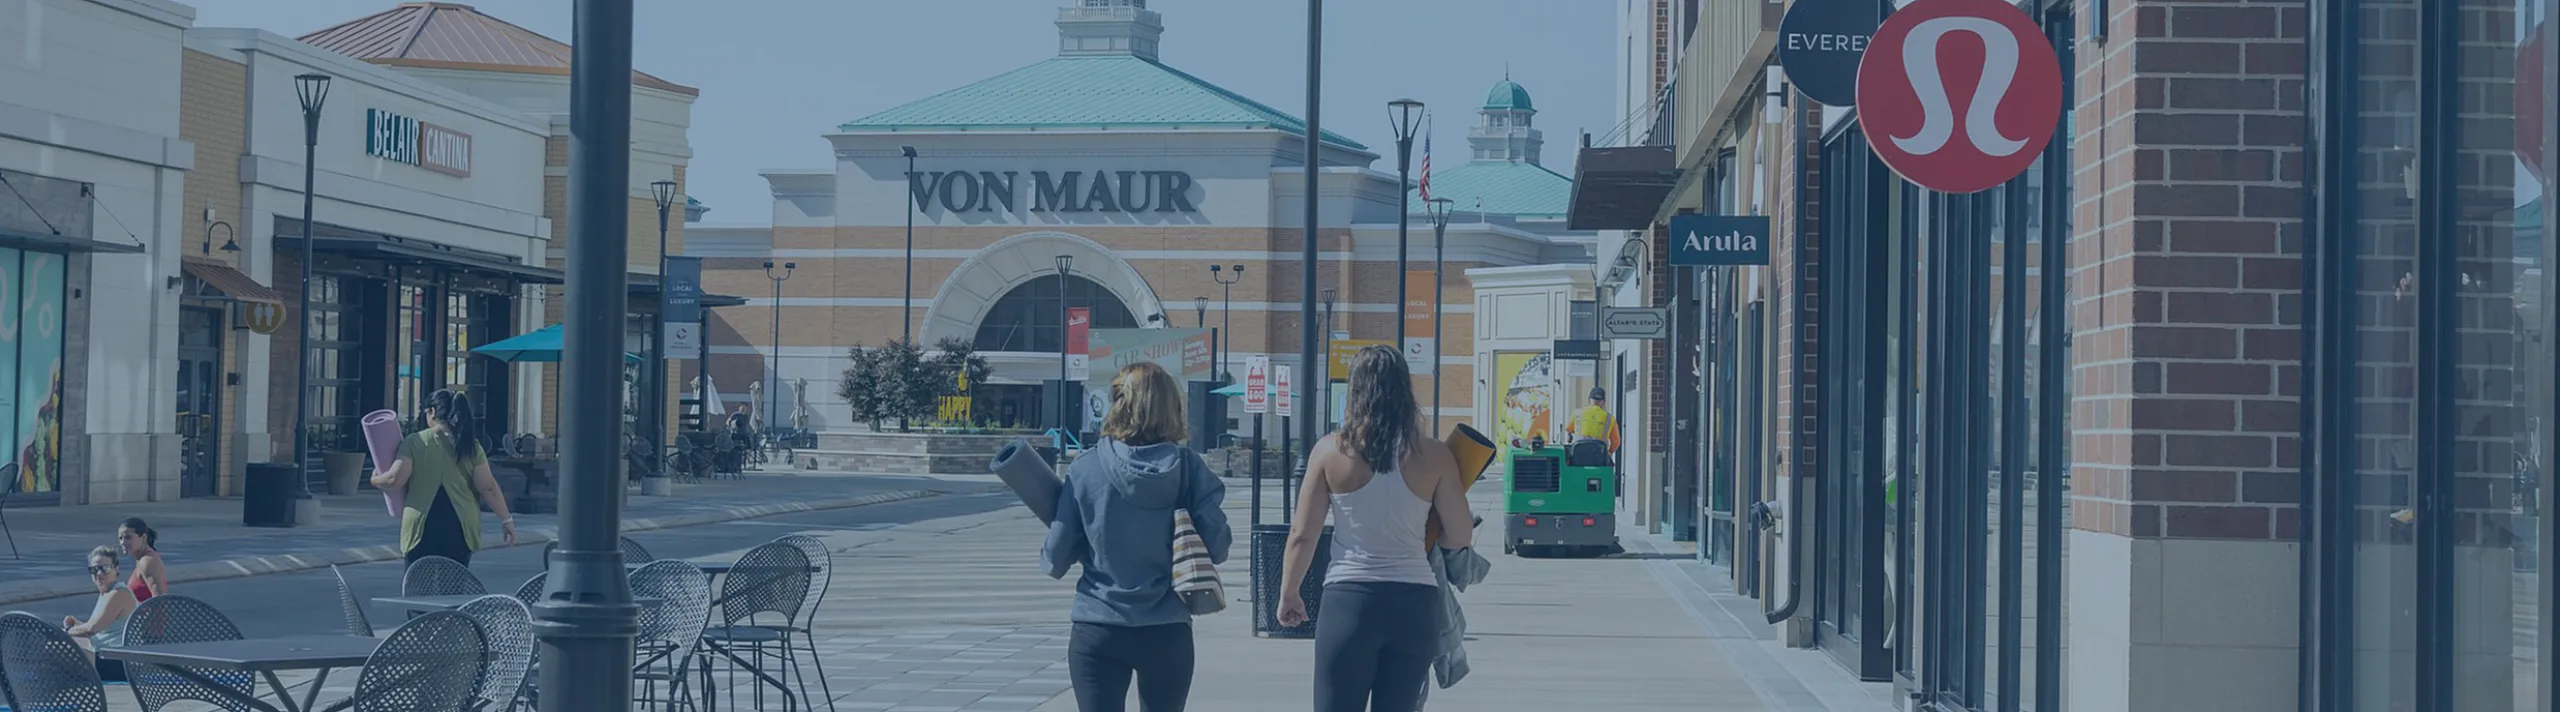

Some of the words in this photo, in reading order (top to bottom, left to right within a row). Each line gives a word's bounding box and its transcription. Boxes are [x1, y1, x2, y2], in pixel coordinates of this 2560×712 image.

[374, 110, 420, 166] BELAIR
[426, 128, 469, 172] CANTINA
[904, 169, 1019, 213] VON
[1031, 169, 1196, 213] MAUR
[1683, 230, 1757, 251] Arula
[1113, 349, 1140, 369] CAR
[1143, 339, 1182, 360] SHOW
[938, 396, 971, 421] HAPPY
